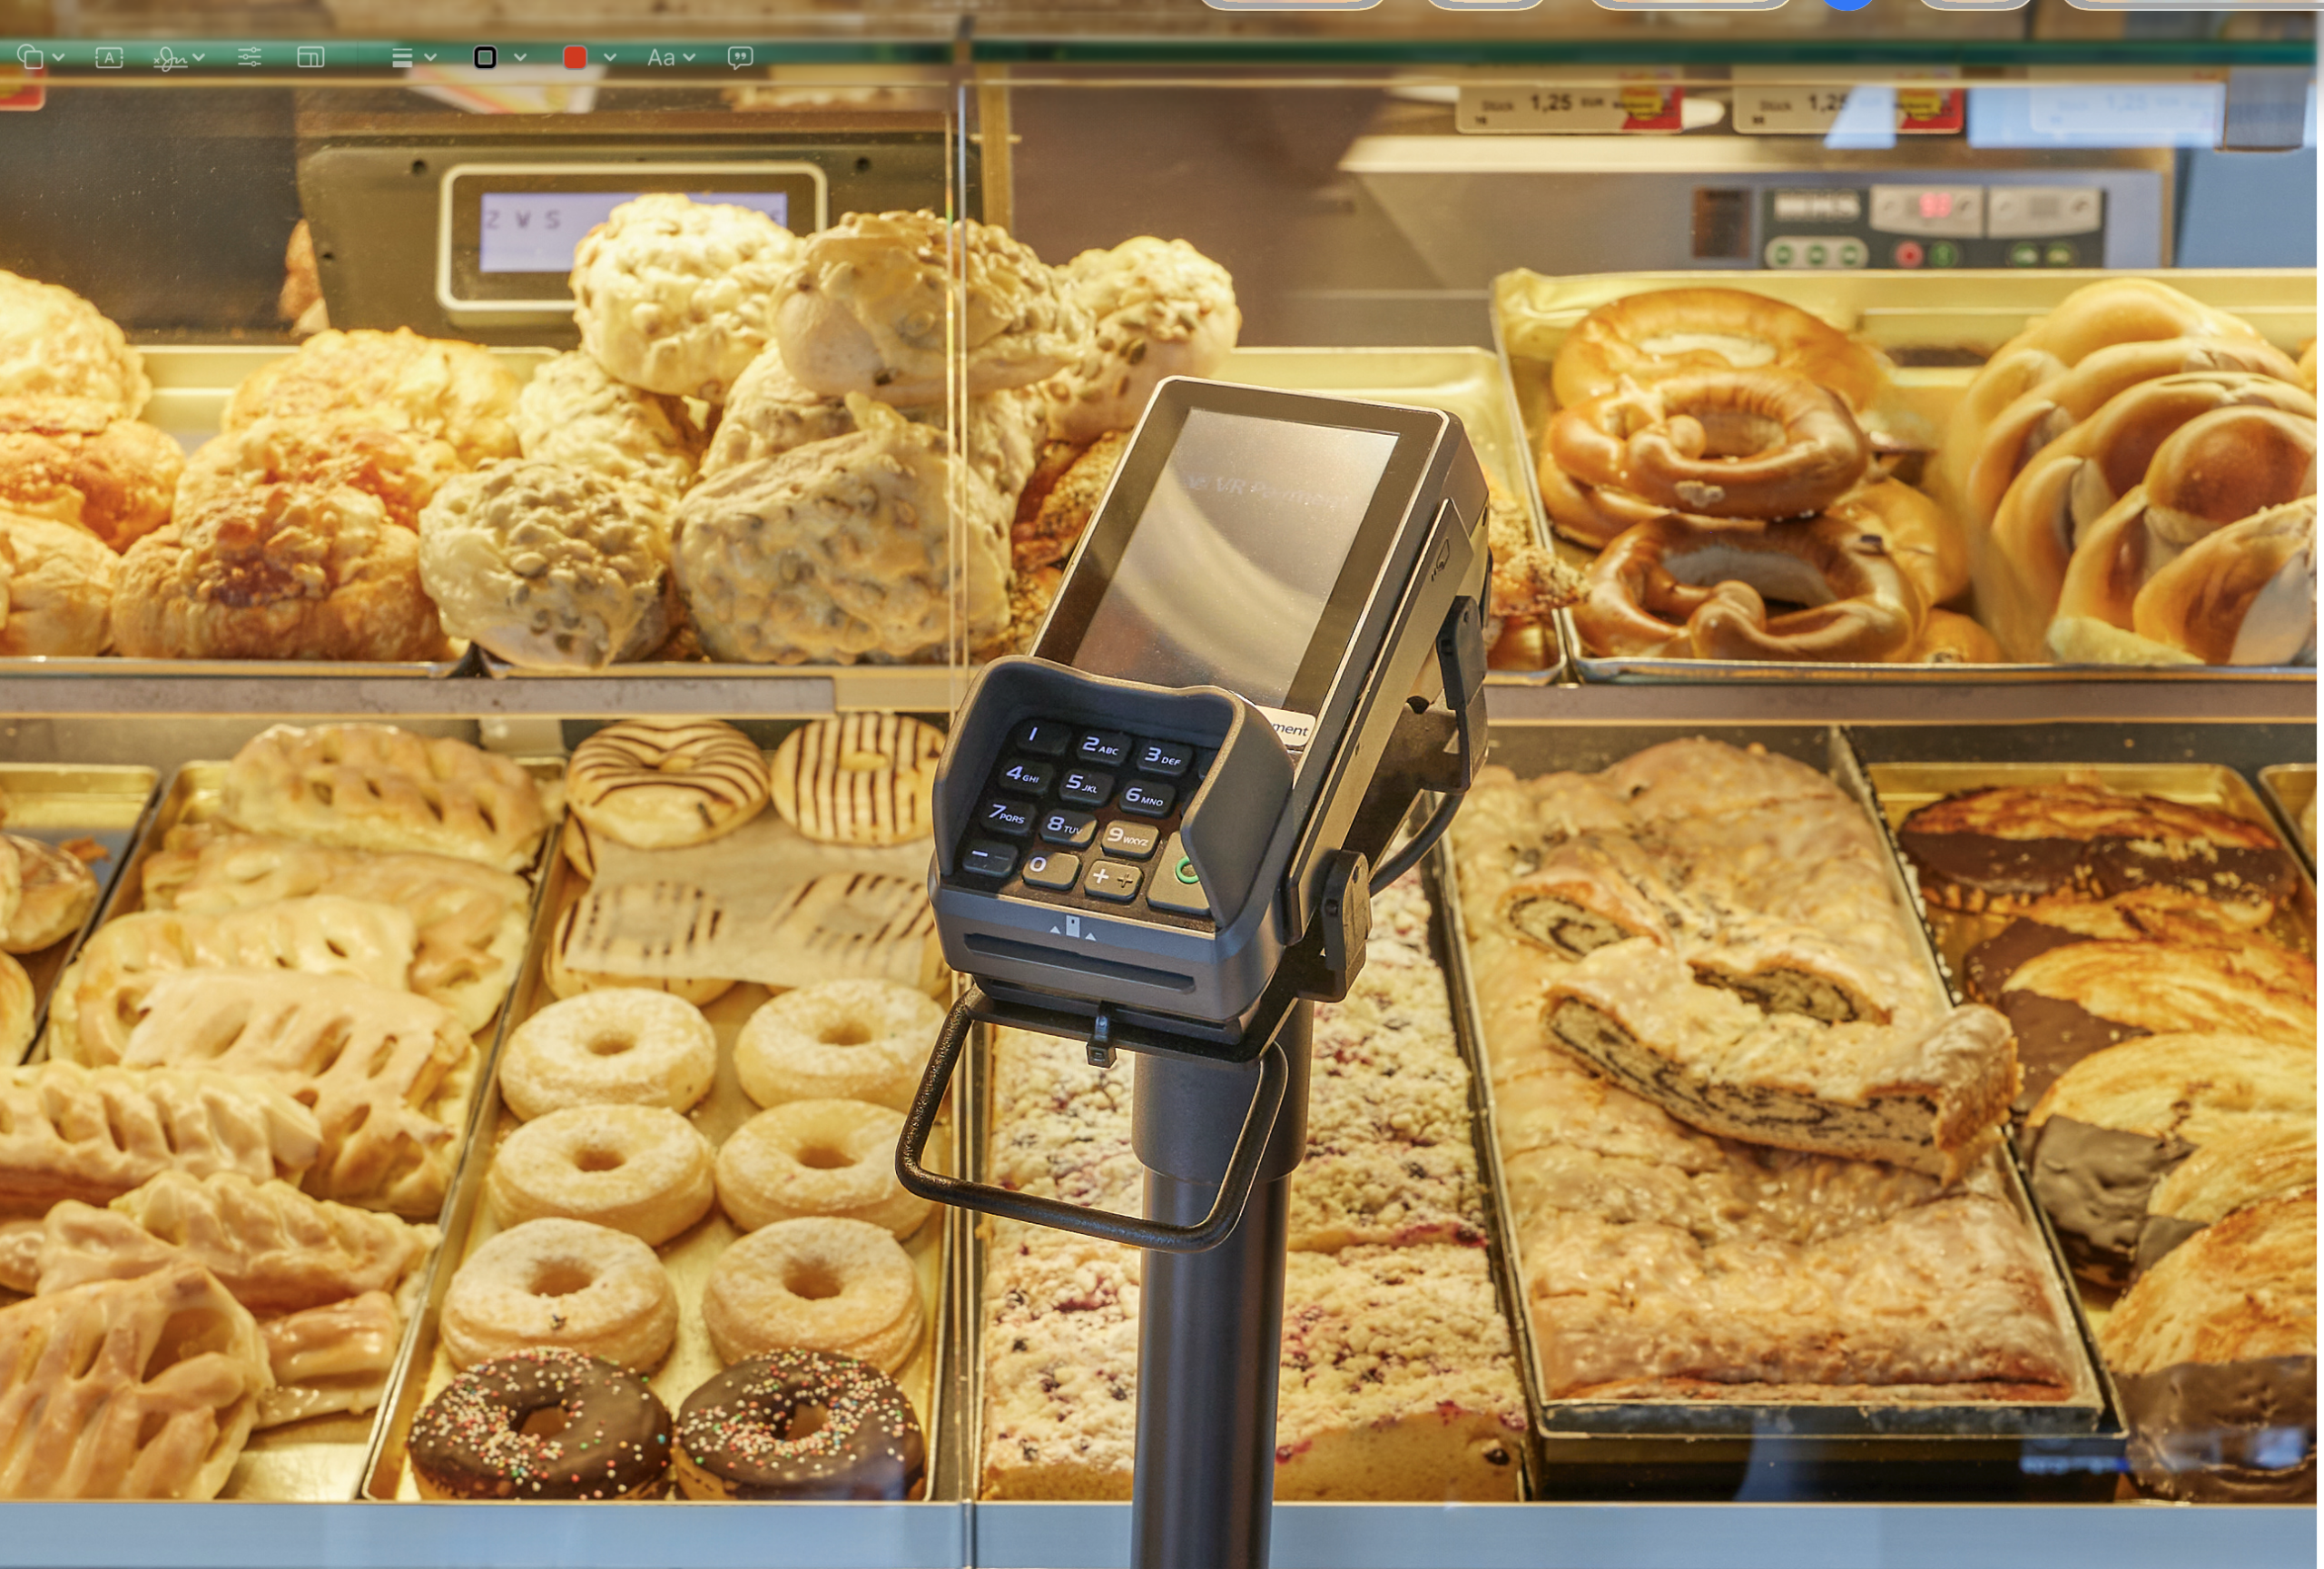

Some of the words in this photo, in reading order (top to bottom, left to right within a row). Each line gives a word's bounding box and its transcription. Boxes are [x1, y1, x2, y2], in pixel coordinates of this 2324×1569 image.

[1530, 94, 1571, 113] 1,25
[1216, 476, 1247, 496] VR
[1083, 736, 1100, 752] 2
[1098, 745, 1119, 756] ABC
[1145, 747, 1162, 762] 3
[1160, 755, 1182, 766] DEF
[1007, 766, 1023, 781] 4
[1021, 775, 1039, 784] GHI
[1066, 775, 1084, 790] 5
[1081, 784, 1098, 794] JKL
[1126, 787, 1143, 802] 6
[1140, 796, 1164, 807] MNO
[990, 804, 1007, 818] 7
[999, 813, 1026, 824] PQRS
[1048, 816, 1065, 832] 8
[1063, 825, 1083, 835] TUV
[1108, 828, 1124, 843] 9
[1122, 835, 1149, 847] WXYZ
[1029, 857, 1047, 873] 0
